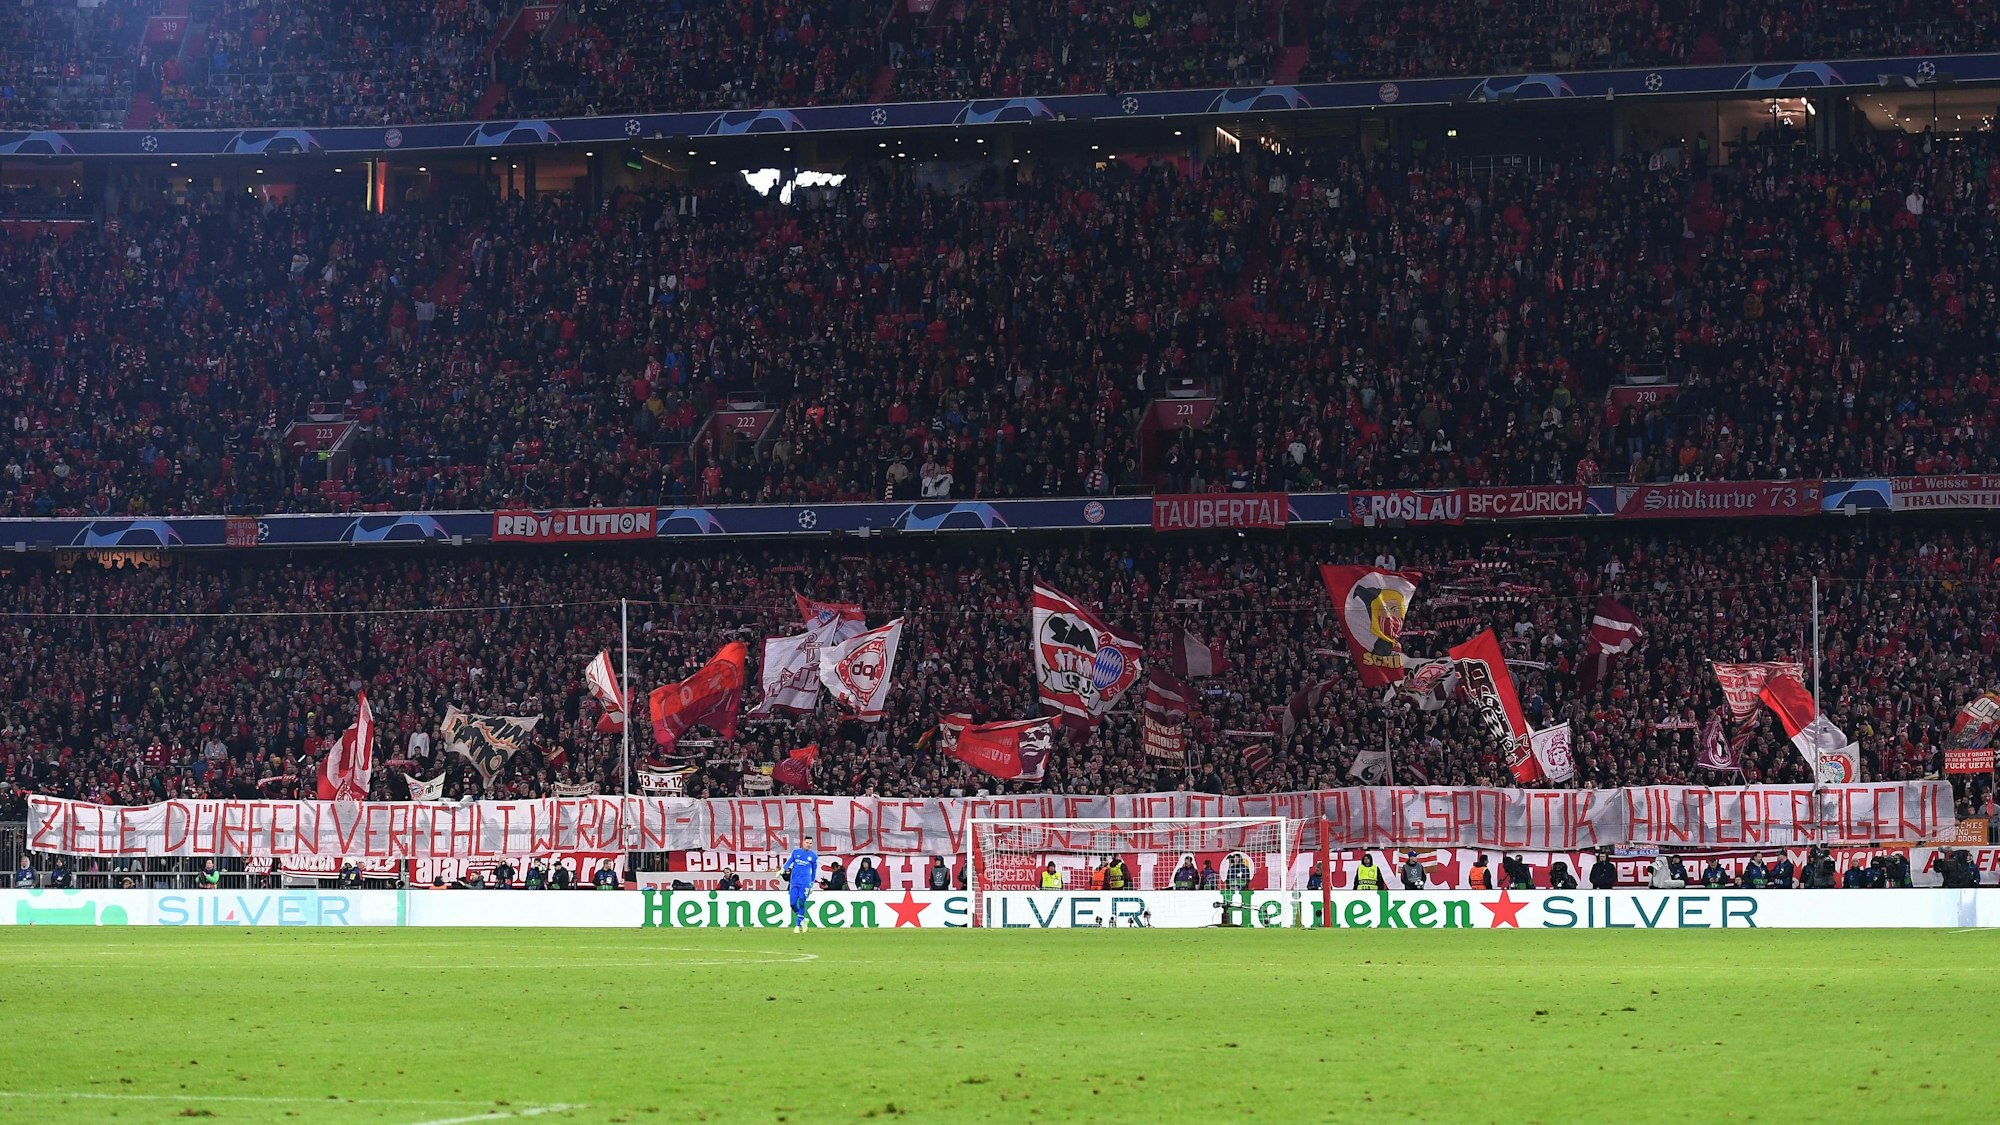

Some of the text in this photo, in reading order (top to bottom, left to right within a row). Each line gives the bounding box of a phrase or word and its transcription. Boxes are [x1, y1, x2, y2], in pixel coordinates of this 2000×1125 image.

[535, 11, 550, 21] 318
[162, 22, 177, 31] 319
[1636, 391, 1656, 402] 220
[1176, 404, 1193, 415] 221
[737, 417, 755, 427] 222
[316, 428, 333, 439] 223
[1924, 477, 1969, 489] Weisse
[1371, 492, 1461, 521] RÖSLAU
[1468, 490, 1583, 514] BFC ZÜRICH
[1644, 489, 1757, 511] Südkurve
[1901, 494, 2000, 507] TRAUNSTEI
[1155, 499, 1286, 527] TAUBERTAL
[1145, 714, 1182, 736] ULTRAS
[1148, 731, 1181, 749] MODUS
[1820, 755, 1844, 765] UEFA
[639, 774, 683, 789] 13 12
[30, 799, 151, 854] ZIELE
[164, 800, 321, 855] DÜRFEN
[332, 803, 516, 857] VERFEHLT
[531, 798, 666, 852] WERDEN
[707, 799, 837, 852] WERTE
[850, 801, 924, 853] DES
[1627, 784, 1938, 845] HINTERFRAGEN!
[1957, 835, 1982, 843] DOORS
[983, 869, 1036, 882] GEGEN
[157, 895, 350, 926] SILVER
[642, 889, 1149, 928] Heineken SILVER
[1220, 889, 1758, 928] Heineken SILVER
